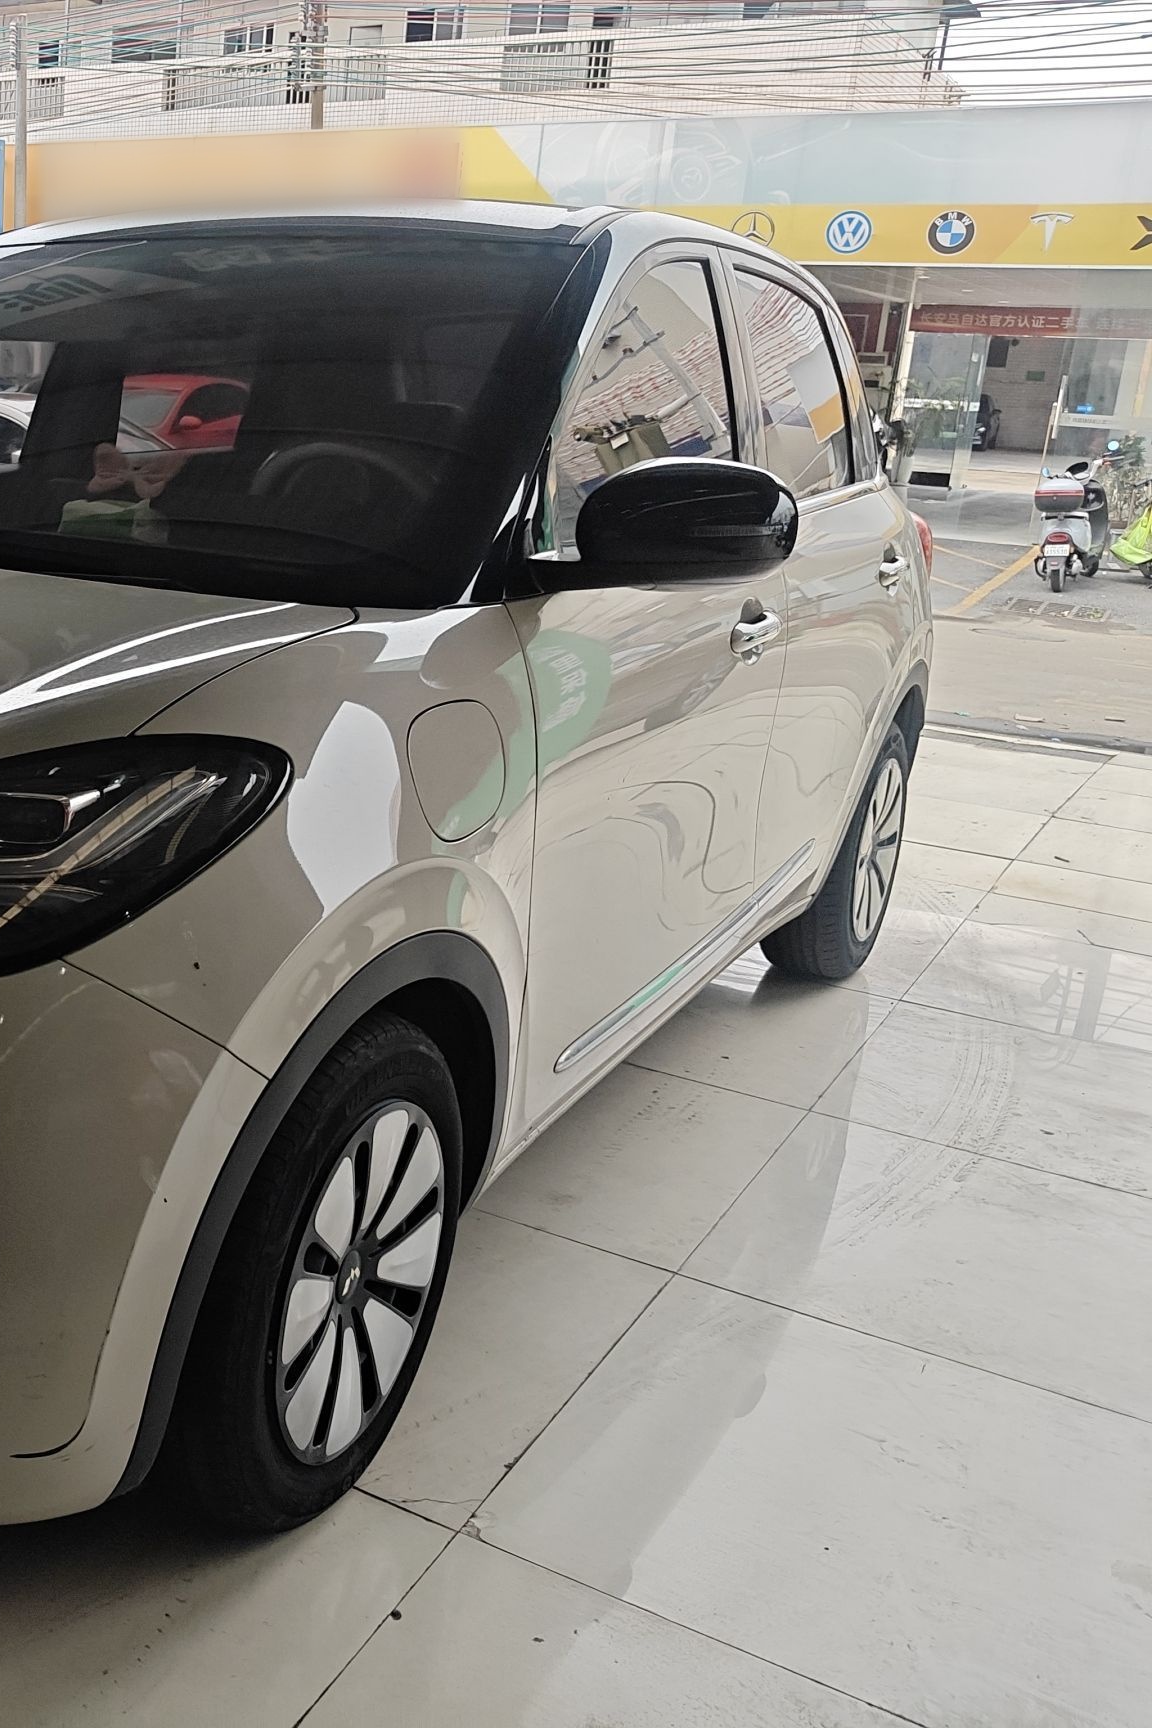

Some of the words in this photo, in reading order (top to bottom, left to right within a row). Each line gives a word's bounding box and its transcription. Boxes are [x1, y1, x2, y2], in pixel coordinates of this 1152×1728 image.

[934, 212, 973, 227] BMW
[920, 312, 1089, 330] 长安马自达官方认证二手车
